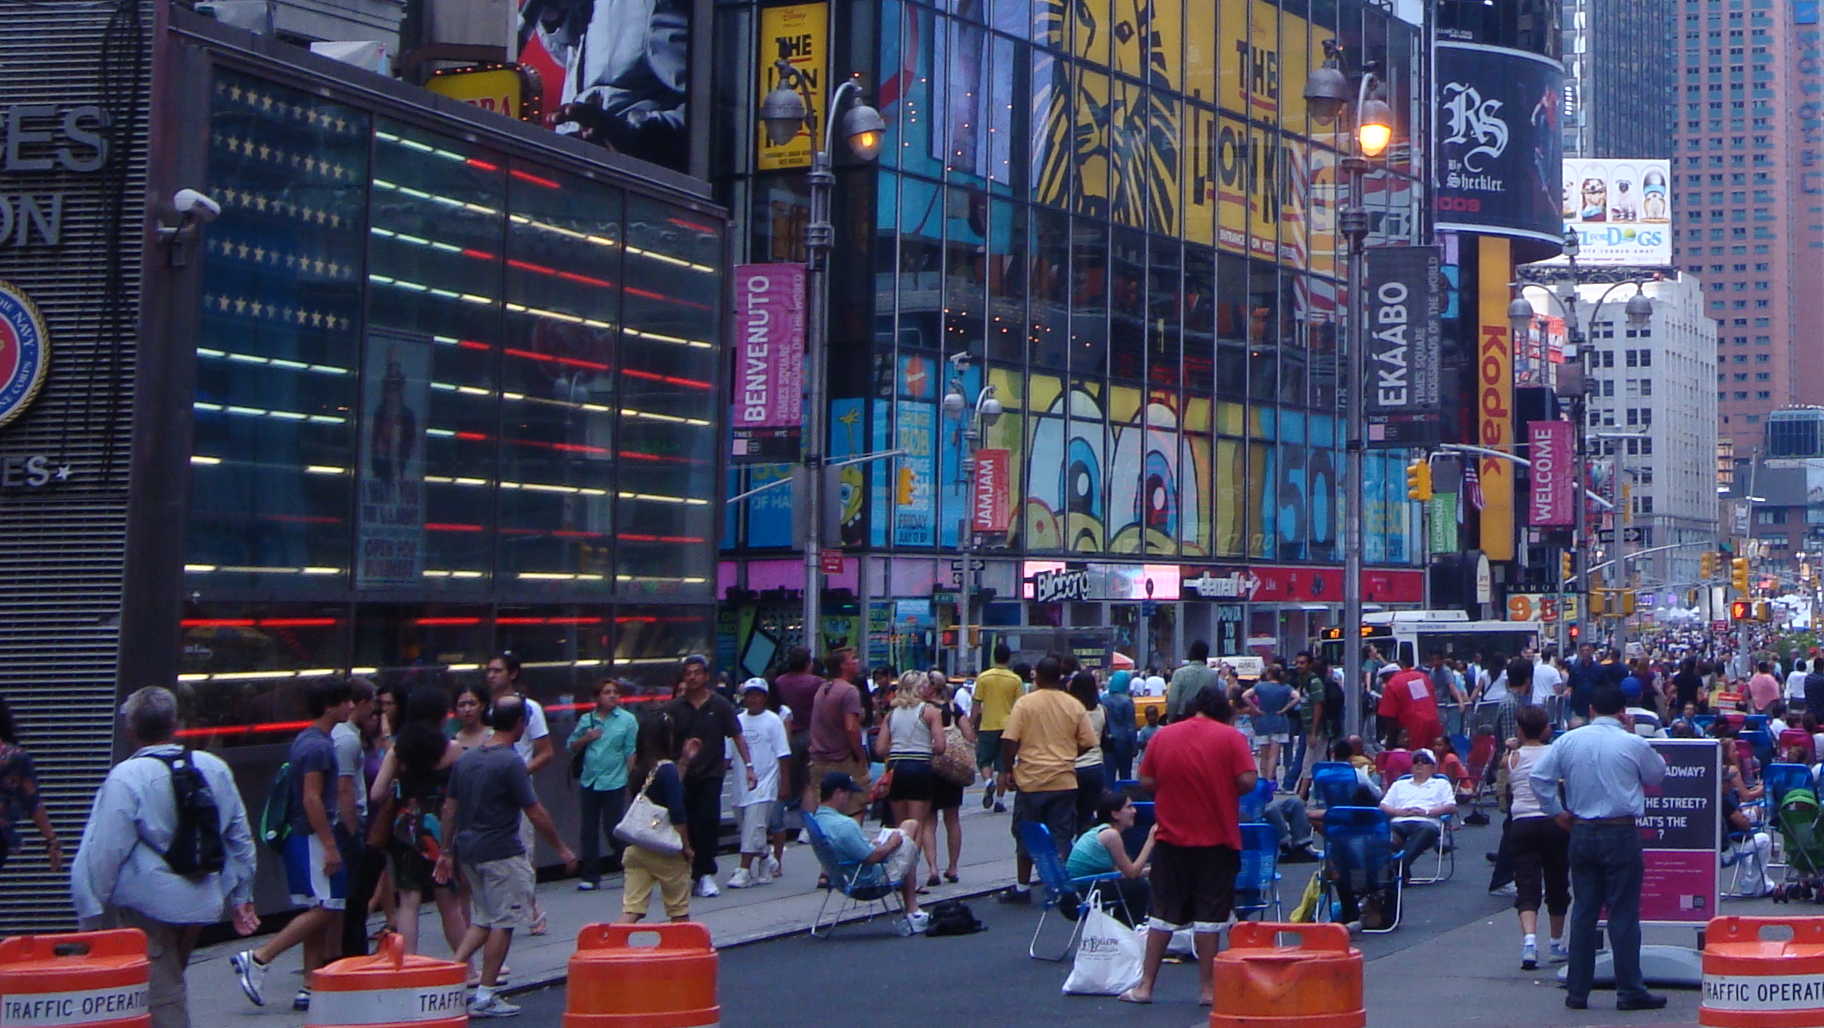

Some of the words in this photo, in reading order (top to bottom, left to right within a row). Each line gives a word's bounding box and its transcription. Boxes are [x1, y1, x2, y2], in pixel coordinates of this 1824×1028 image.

[1236, 39, 1278, 99] THE
[0, 106, 111, 171] ES
[13, 312, 35, 347] NAVY
[744, 275, 770, 421] BENVENUTO
[1372, 282, 1408, 406] EKÁÁBO
[1415, 327, 1426, 368] SQUARE
[1415, 371, 1426, 403] TIMES
[1482, 325, 1508, 476] Kodak
[977, 460, 994, 527] JAMJAM
[1535, 429, 1552, 520] WELCOME
[1037, 570, 1089, 602] Billabong
[1635, 816, 1664, 827] HAT'S
[1667, 816, 1687, 827] THE
[1662, 797, 1707, 809] STREET?
[5, 998, 74, 1019] TRAFFIC
[1703, 981, 1749, 1001] TRAFFIC
